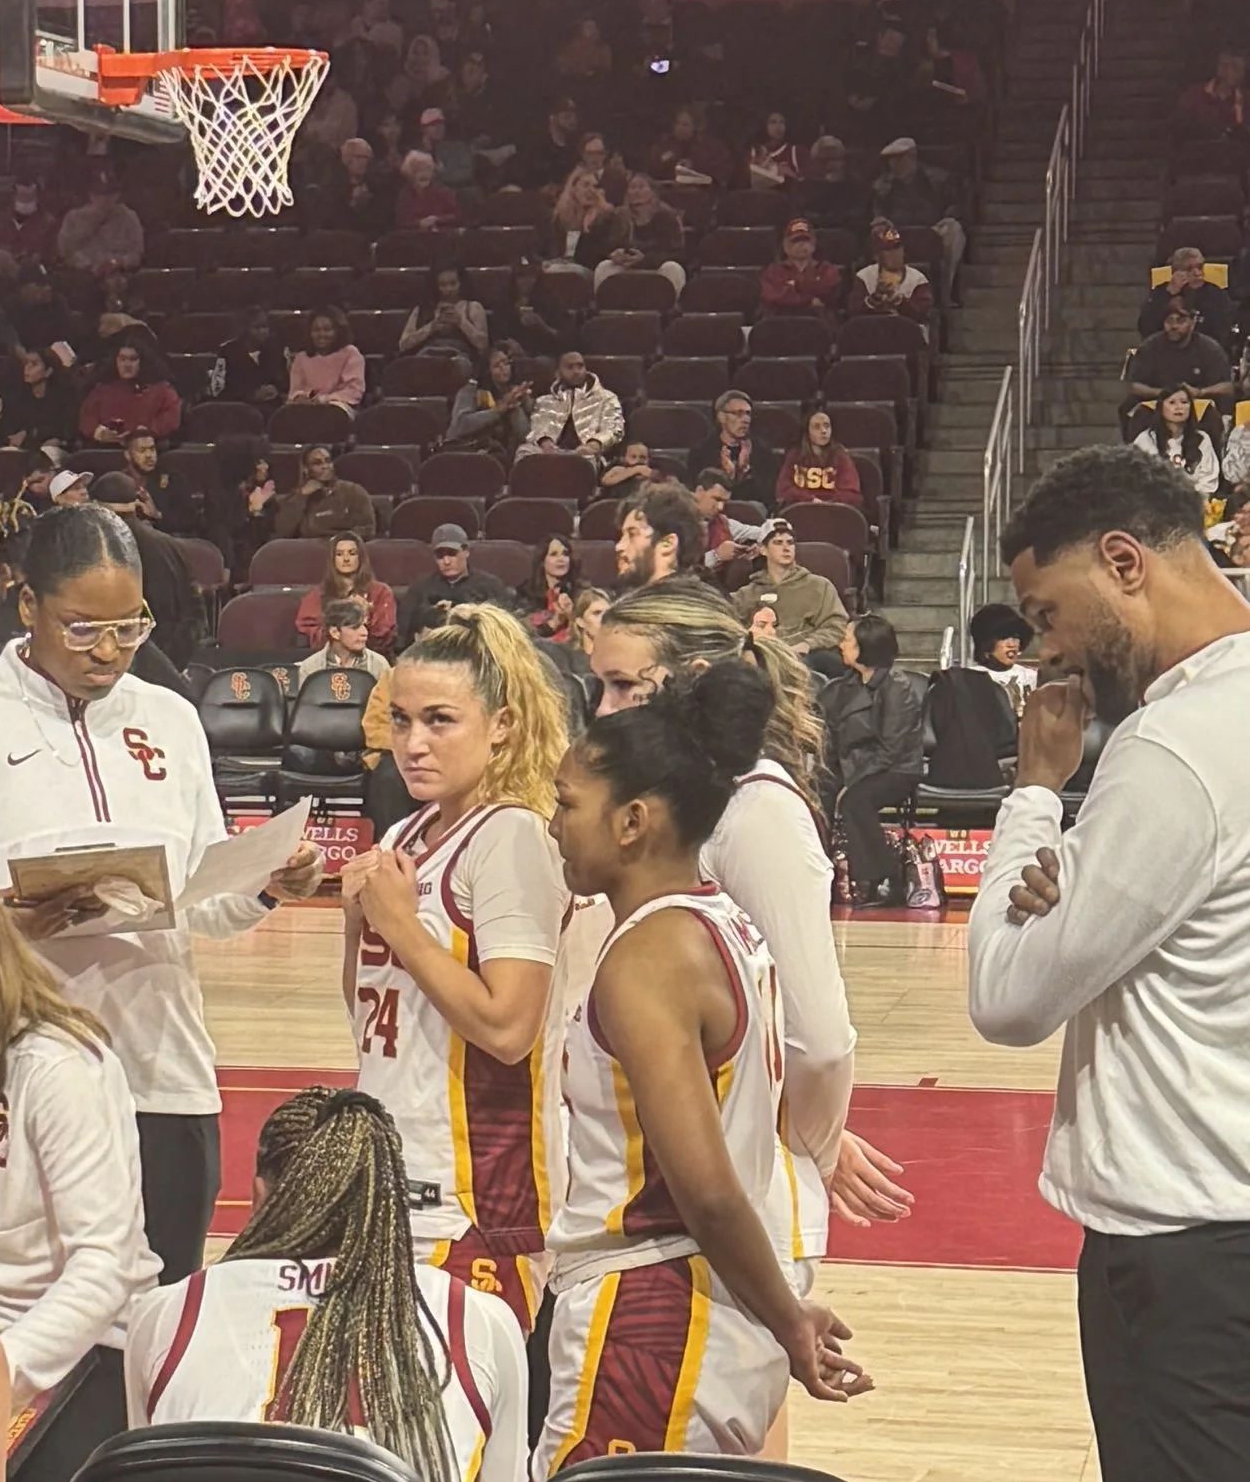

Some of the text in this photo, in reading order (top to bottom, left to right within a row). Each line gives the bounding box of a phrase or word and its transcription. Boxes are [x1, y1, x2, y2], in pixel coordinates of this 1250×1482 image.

[122, 727, 167, 781] SC
[939, 858, 988, 875] ARG
[357, 987, 400, 1059] 24
